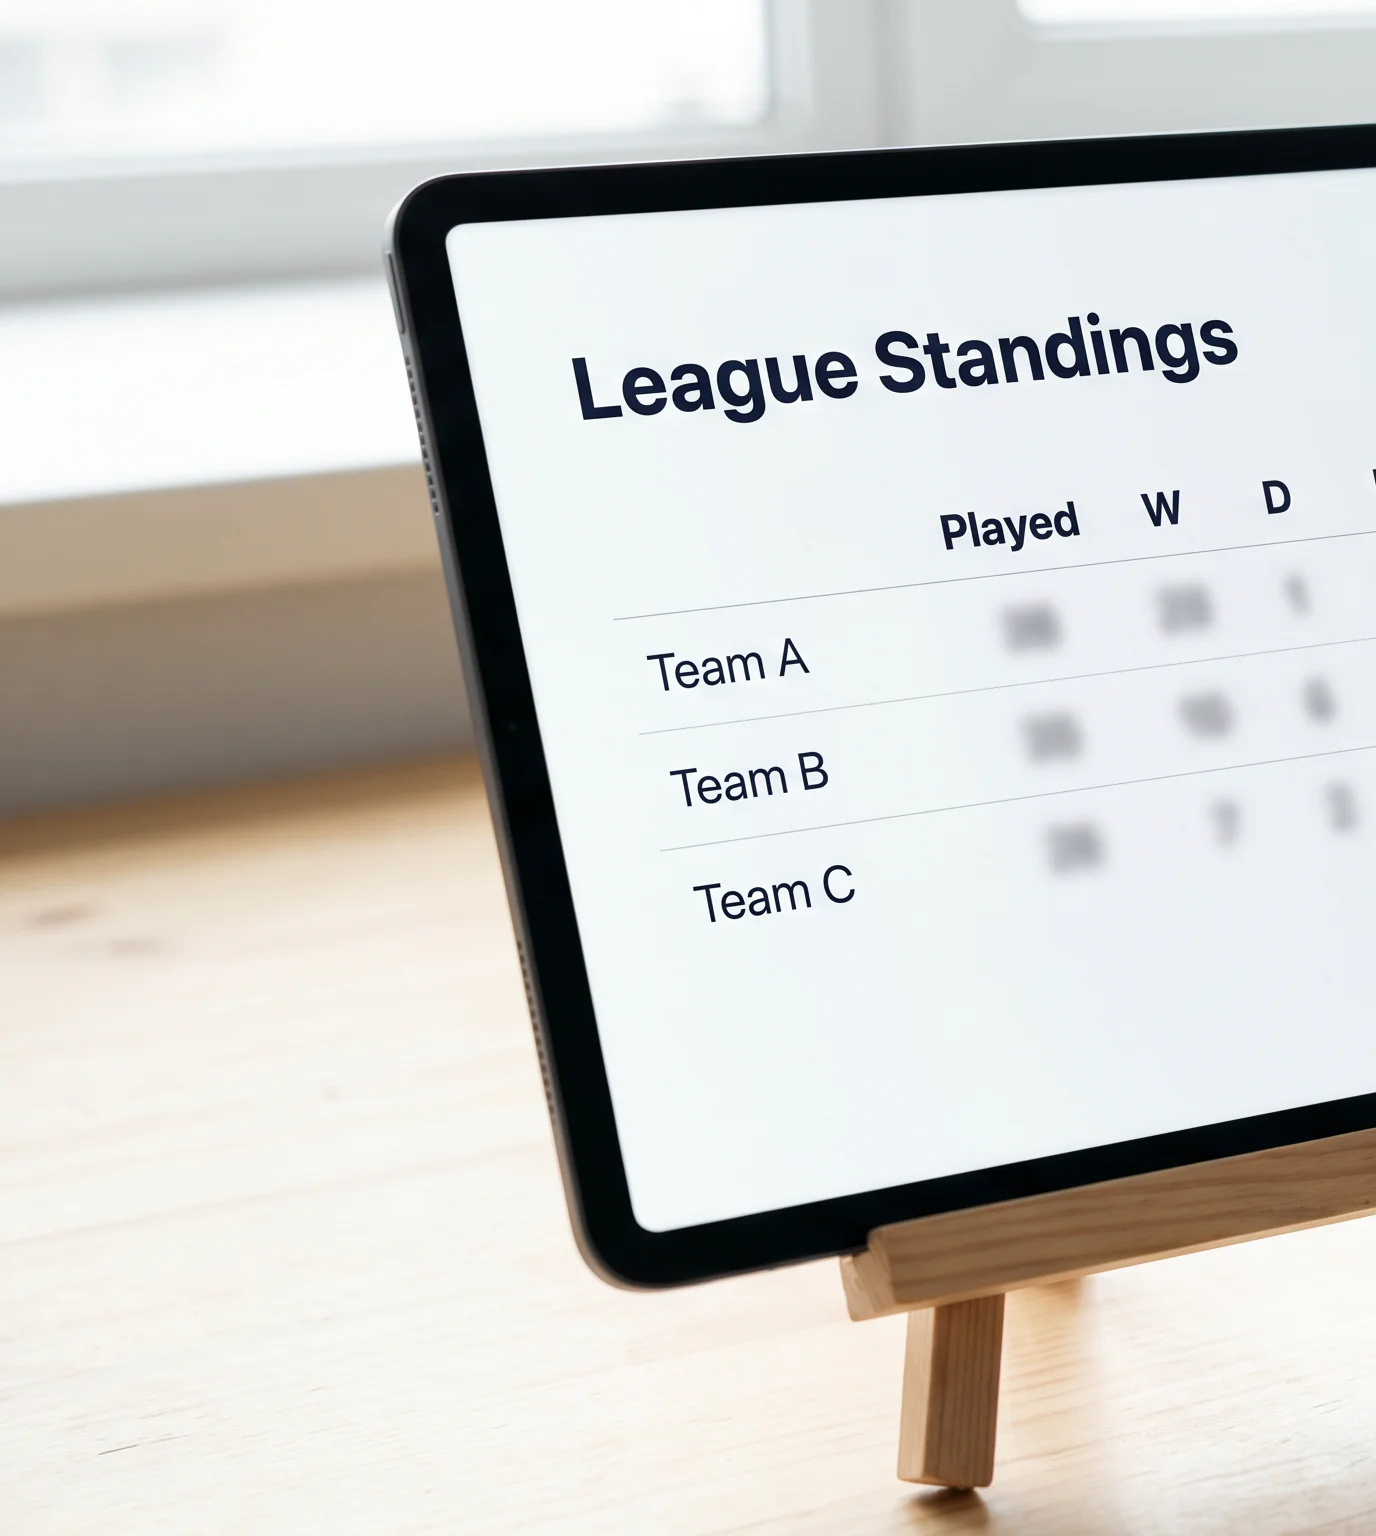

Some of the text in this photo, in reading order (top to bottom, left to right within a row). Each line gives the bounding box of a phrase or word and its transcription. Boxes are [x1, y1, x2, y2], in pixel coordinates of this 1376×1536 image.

[571, 311, 1239, 424] League Standings
[939, 500, 1081, 553] Played
[1139, 489, 1181, 528] W
[1261, 479, 1292, 515] D
[646, 637, 811, 692] Team A
[669, 751, 829, 808] Team B
[692, 864, 856, 923] Team C
